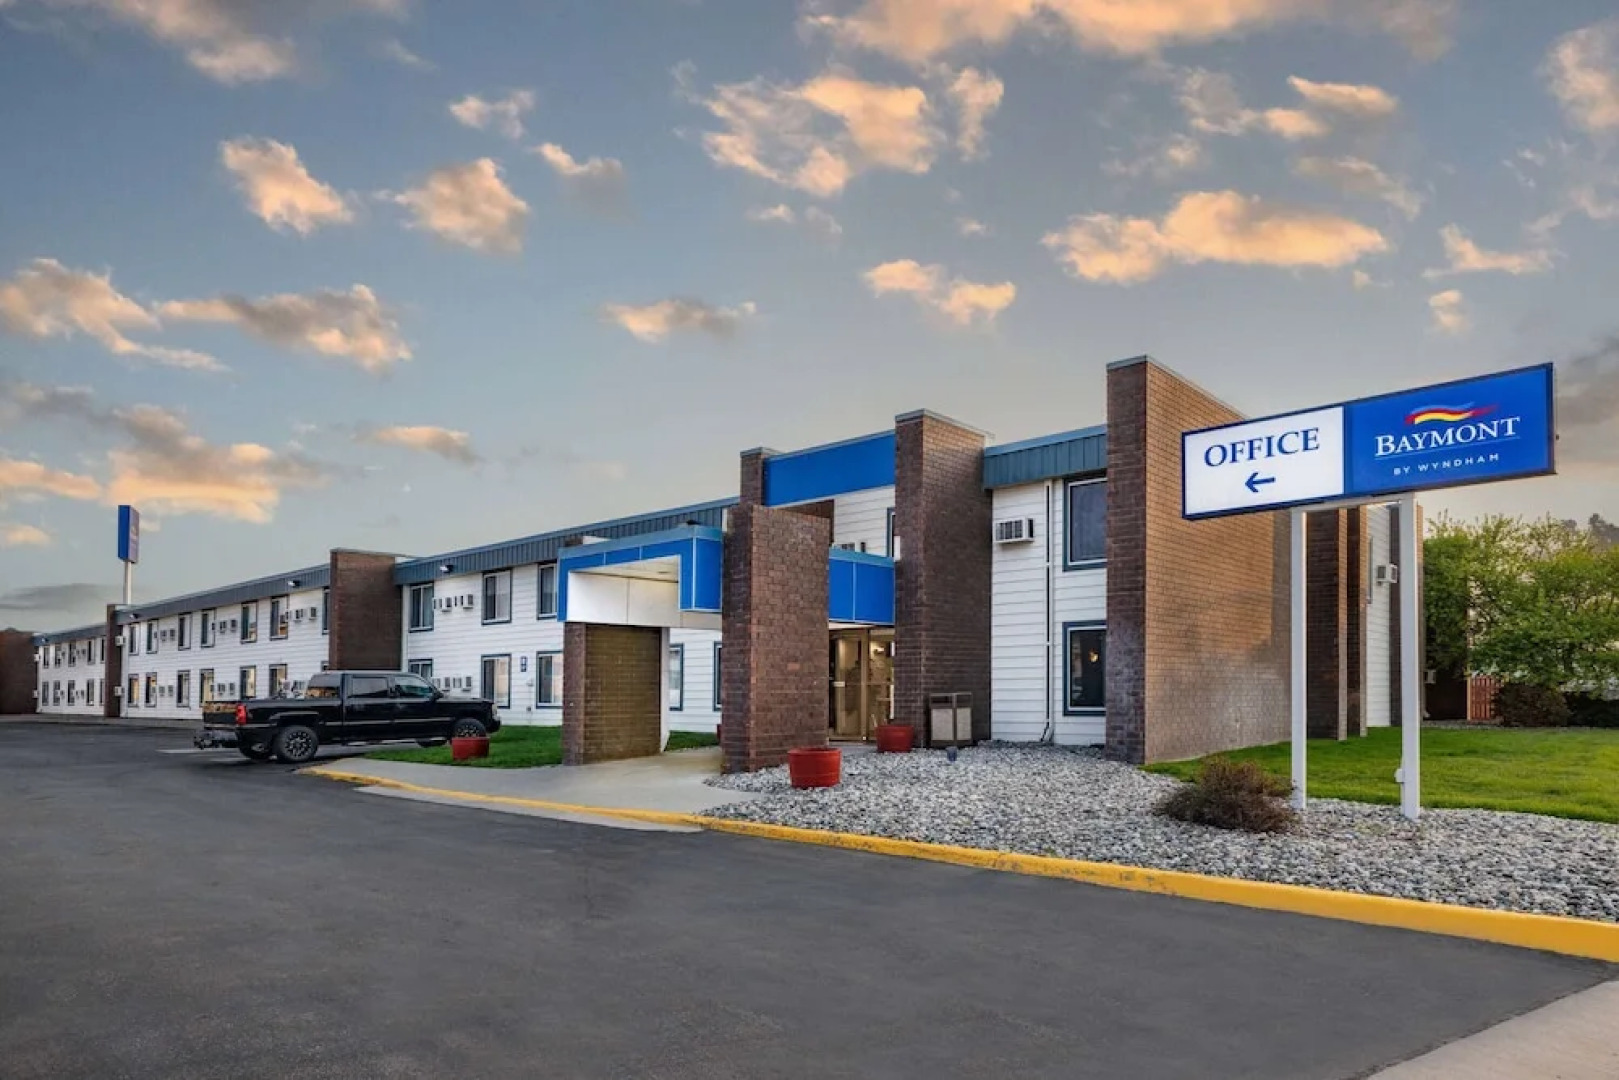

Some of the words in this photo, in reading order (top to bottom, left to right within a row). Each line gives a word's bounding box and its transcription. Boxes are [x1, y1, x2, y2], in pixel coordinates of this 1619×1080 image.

[1204, 427, 1319, 467] OFFICE
[1375, 416, 1520, 456] BAYMONT
[1394, 466, 1410, 475] BY
[1417, 453, 1499, 473] WYNDHAM
